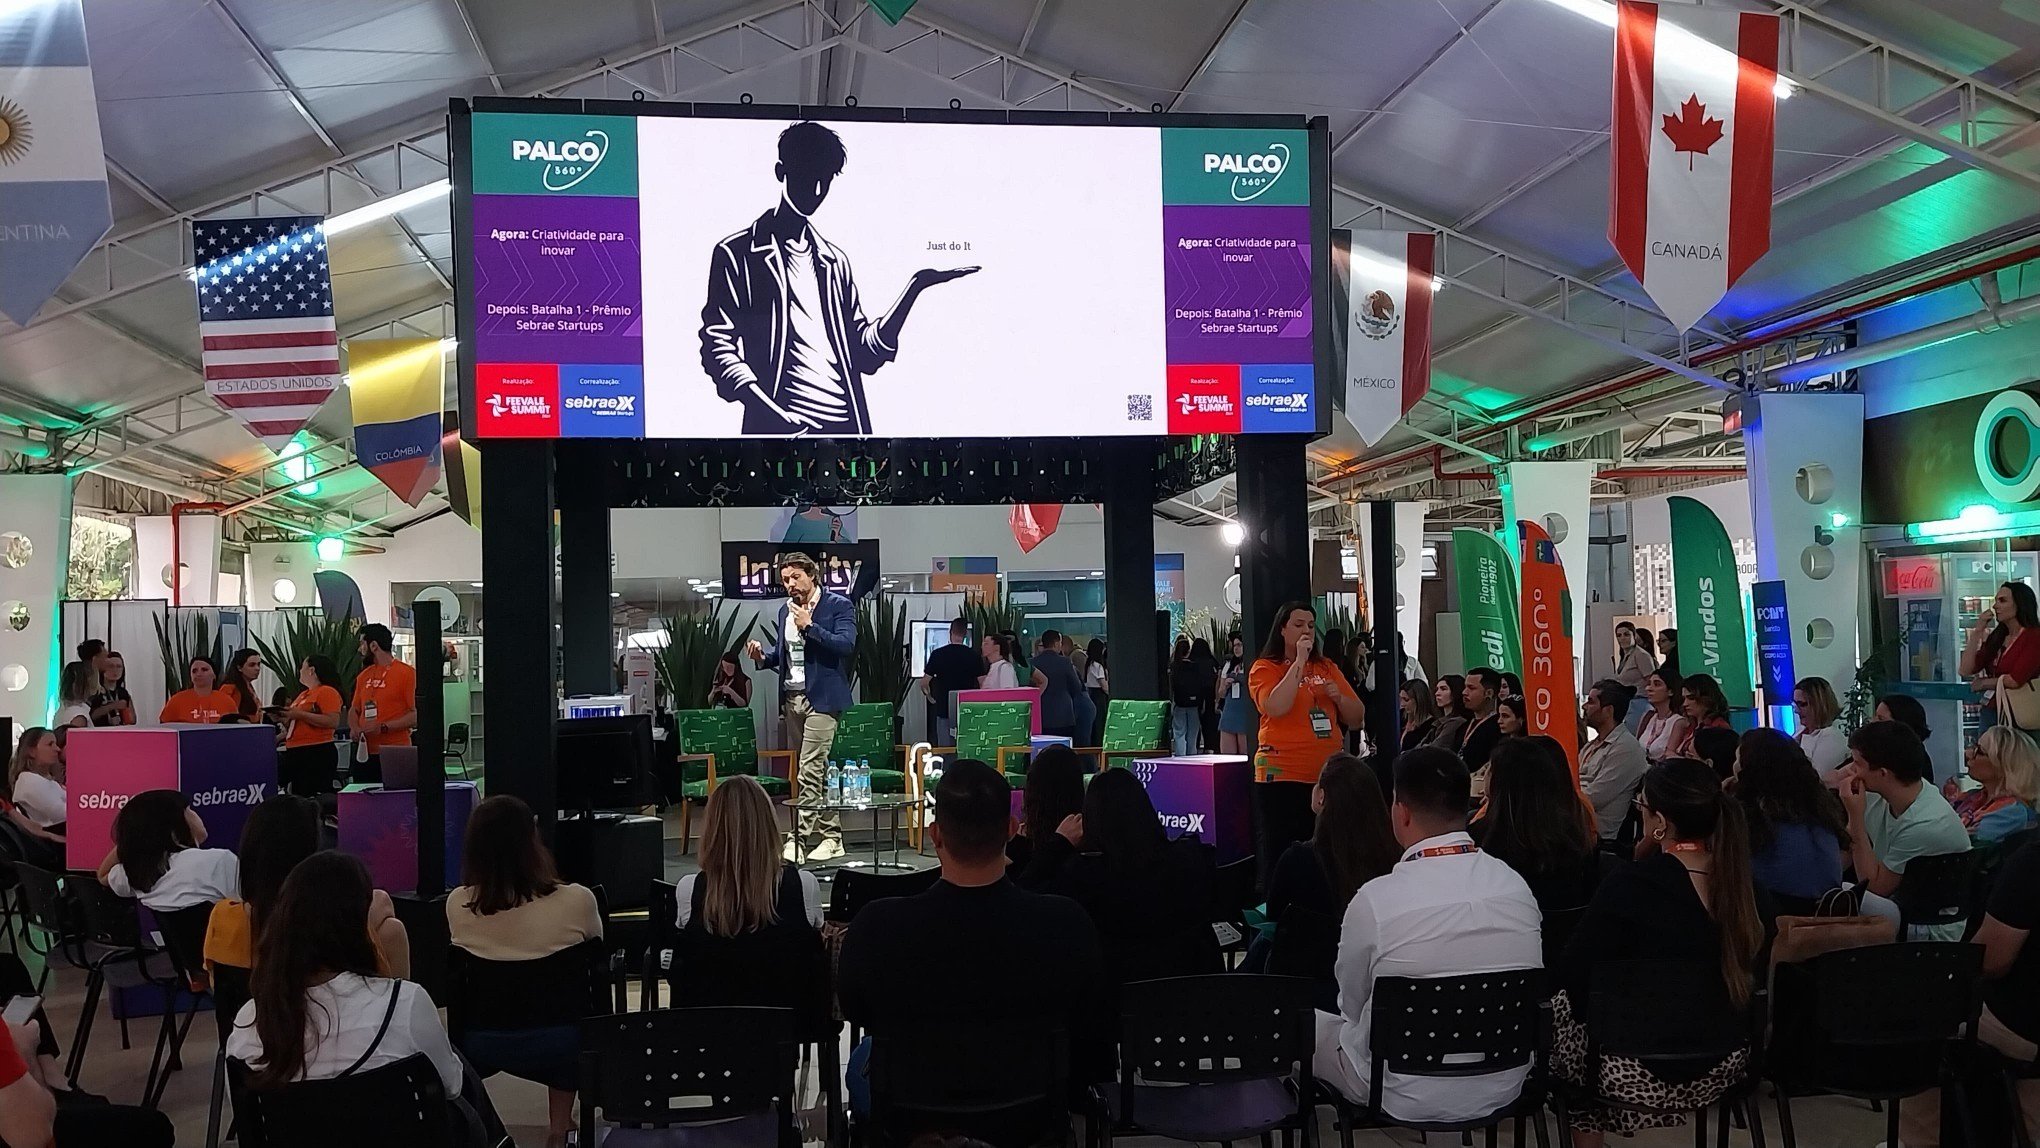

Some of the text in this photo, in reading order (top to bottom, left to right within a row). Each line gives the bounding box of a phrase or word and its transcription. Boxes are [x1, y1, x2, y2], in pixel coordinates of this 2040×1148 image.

[512, 140, 600, 162] PALCO
[1204, 153, 1282, 174] PALCO
[490, 228, 624, 243] Agora: Criatividade para
[541, 245, 576, 256] inovar
[926, 240, 972, 251] Just do It
[1177, 237, 1297, 250] Agora: Criatividade para
[1222, 252, 1254, 262] inovar
[1651, 241, 1722, 261] CANADÁ
[487, 303, 529, 317] Depois:
[531, 304, 573, 315] Batalha
[576, 304, 582, 315] 1
[592, 304, 632, 316] Prêmio
[1175, 308, 1212, 320] Depois:
[1214, 308, 1251, 318] Batalha
[1253, 308, 1259, 318] 1
[1267, 307, 1303, 318] Prêmio
[516, 320, 604, 333] Sebrae Startups
[1201, 323, 1279, 335] Sebrae Startups
[217, 376, 333, 392] ESTADOS UNIDOS
[1353, 375, 1396, 389] MÉXICO
[505, 396, 545, 406] FEEVALE
[1193, 395, 1228, 404] FEEVALE
[510, 404, 551, 415] SUMMIT
[1198, 403, 1234, 412] SUMMIT
[374, 444, 423, 462] COLÔMBIA
[739, 551, 863, 595] Infity
[1479, 556, 1490, 604] Pioneira
[1489, 560, 1498, 588] 1902
[1698, 577, 1723, 685] -Vindos
[78, 790, 134, 810] sebra
[1157, 811, 1206, 833] braeX
